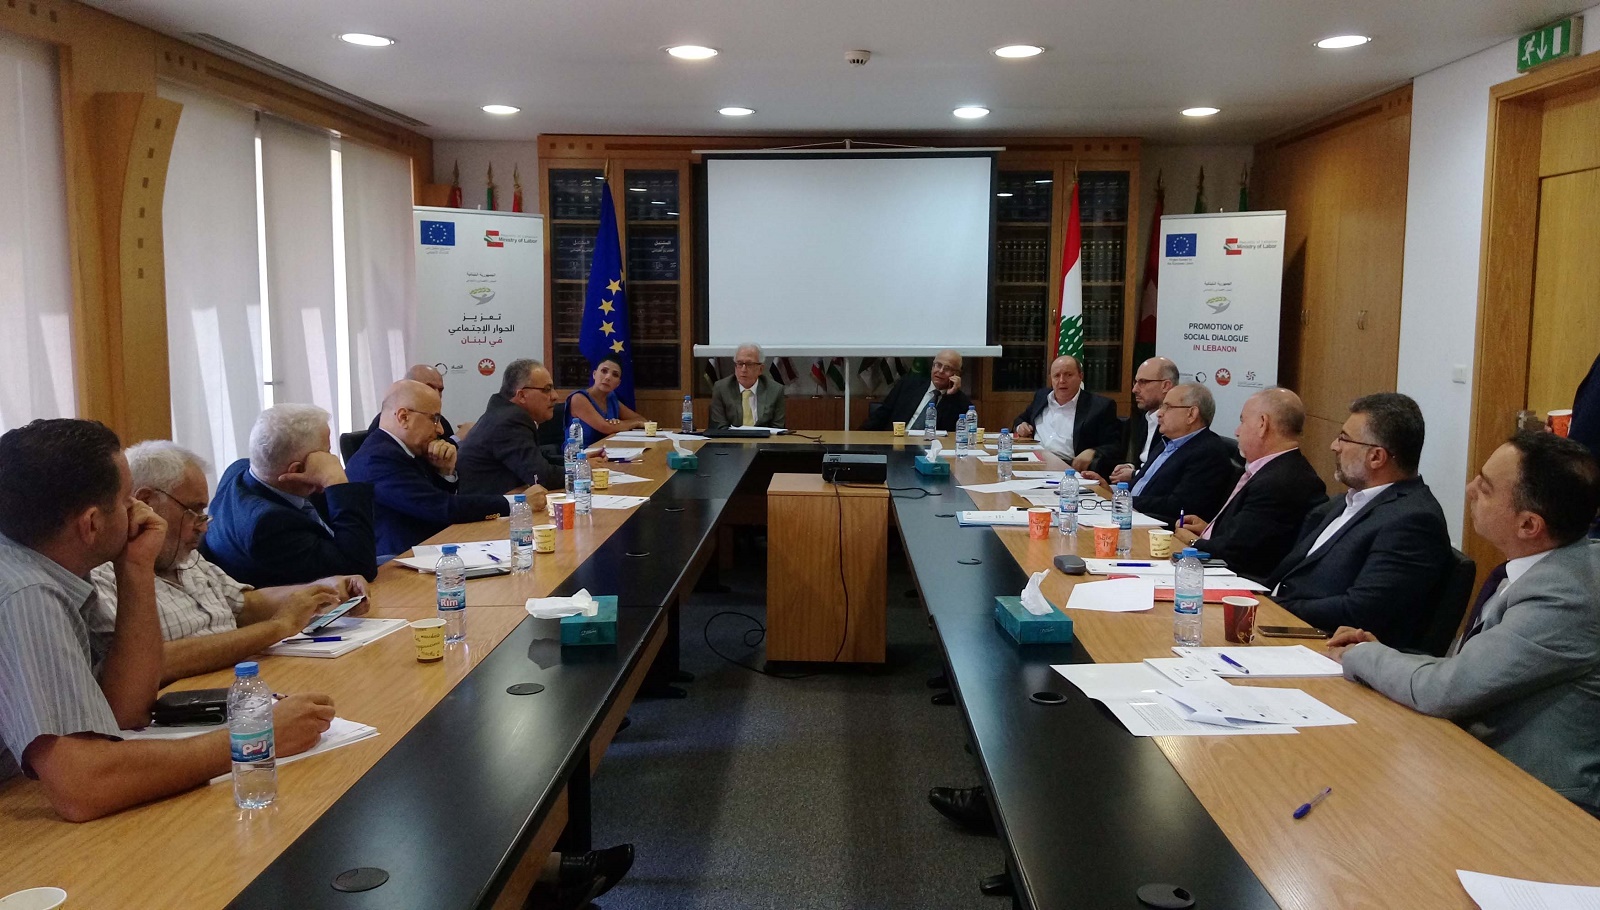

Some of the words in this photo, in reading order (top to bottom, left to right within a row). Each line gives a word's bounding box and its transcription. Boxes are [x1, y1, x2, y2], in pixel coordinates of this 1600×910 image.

[448, 324, 491, 336] الإجتماعي
[492, 324, 515, 334] الحوار
[1188, 322, 1233, 331] PROMOTION
[1233, 323, 1244, 331] OF
[461, 335, 487, 345] لبنان
[488, 336, 503, 348] في
[1183, 333, 1210, 341] SOCIAL
[1211, 333, 1249, 343] DIALOGUE
[1202, 344, 1238, 353] LEBANON
[440, 598, 459, 607] Rim
[242, 740, 267, 756] ريم
